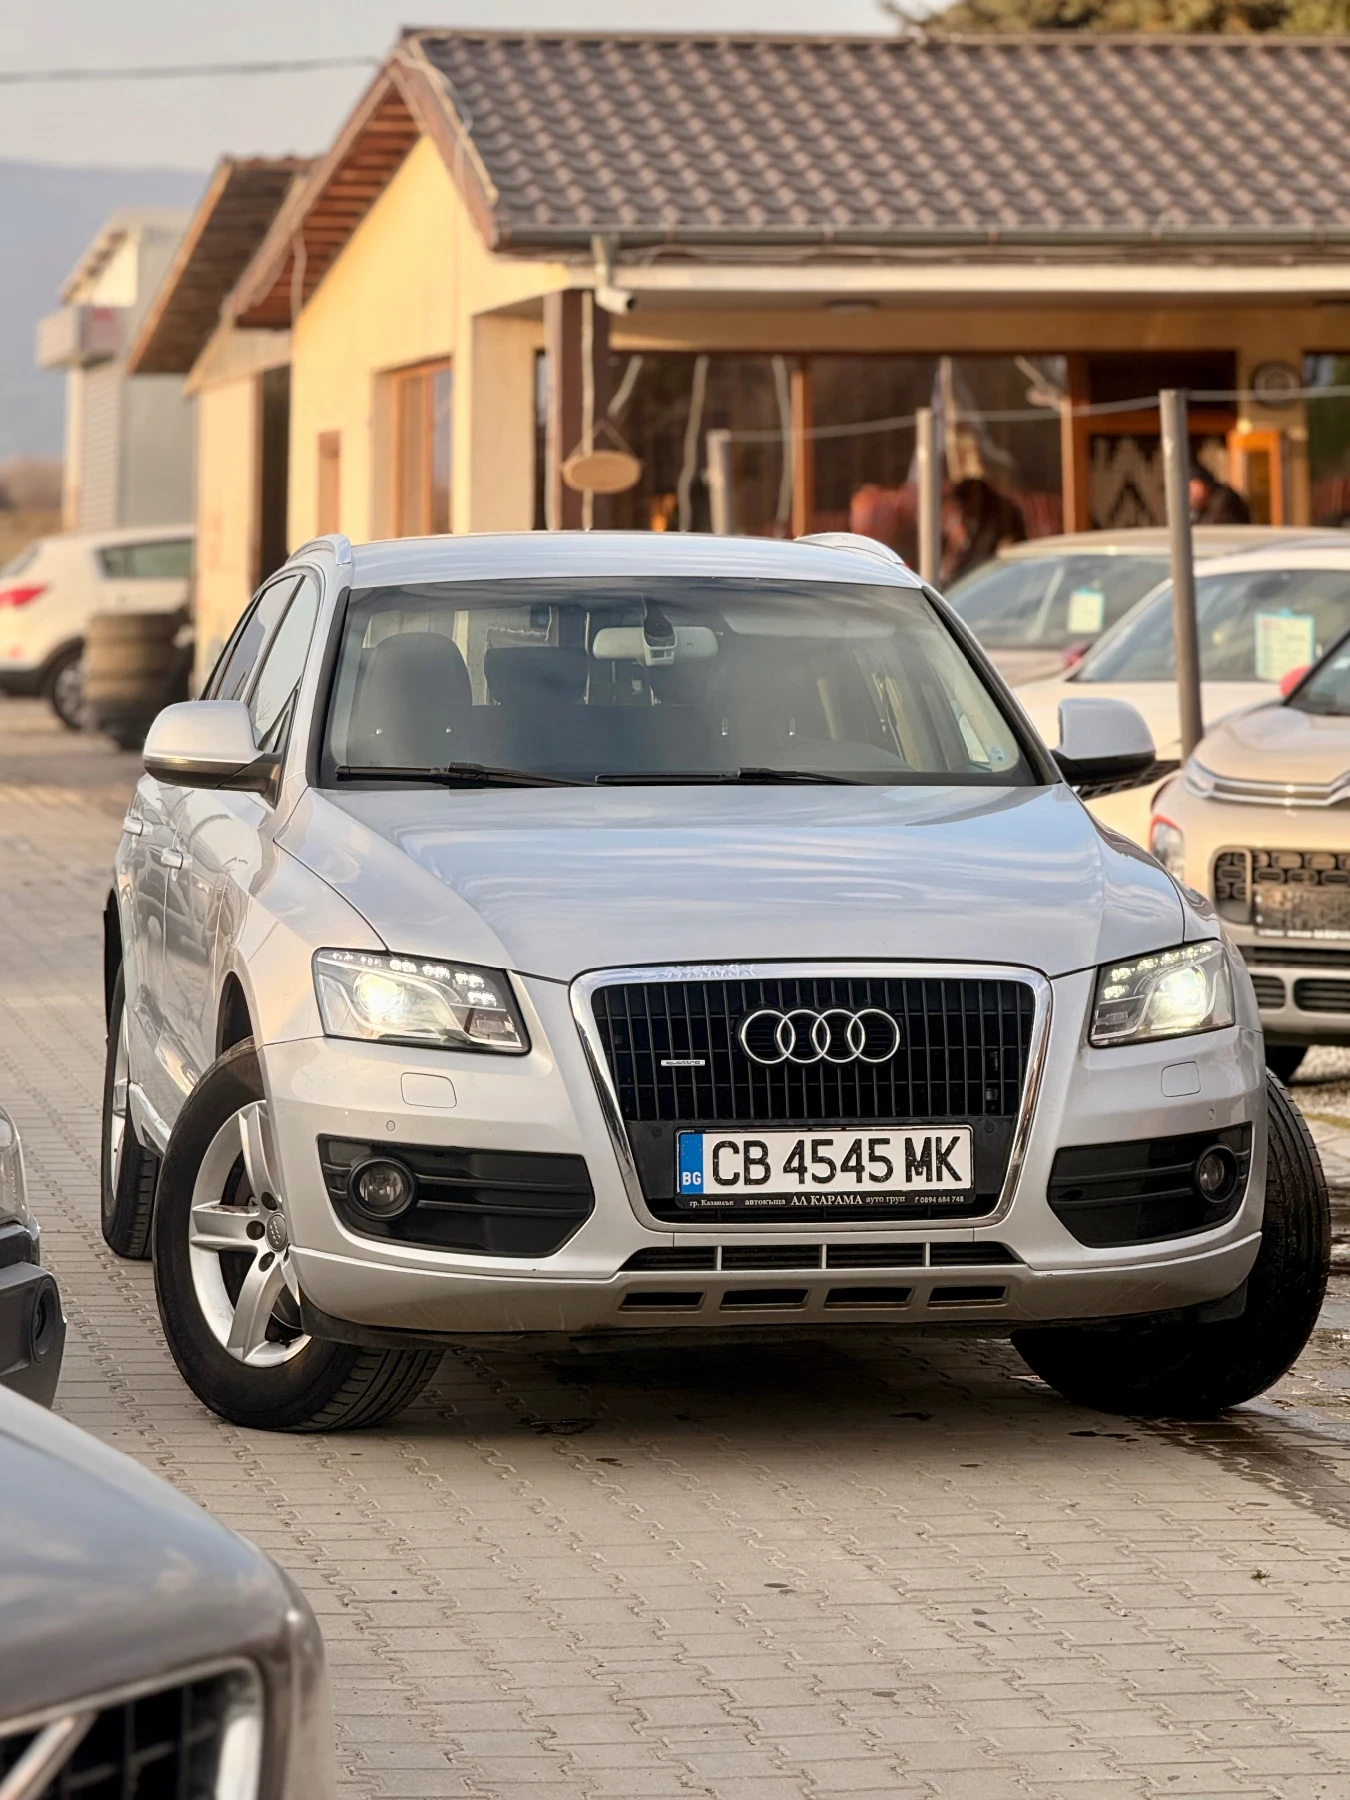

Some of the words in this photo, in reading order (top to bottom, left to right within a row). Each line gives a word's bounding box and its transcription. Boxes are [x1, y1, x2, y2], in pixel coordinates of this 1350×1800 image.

[712, 1140, 770, 1186] CB
[782, 1137, 894, 1184] 4545
[904, 1136, 963, 1183] MK
[682, 1171, 702, 1186] BG
[810, 1194, 863, 1206] КАРАМА
[866, 1196, 884, 1204] ауто
[886, 1196, 906, 1204] груп
